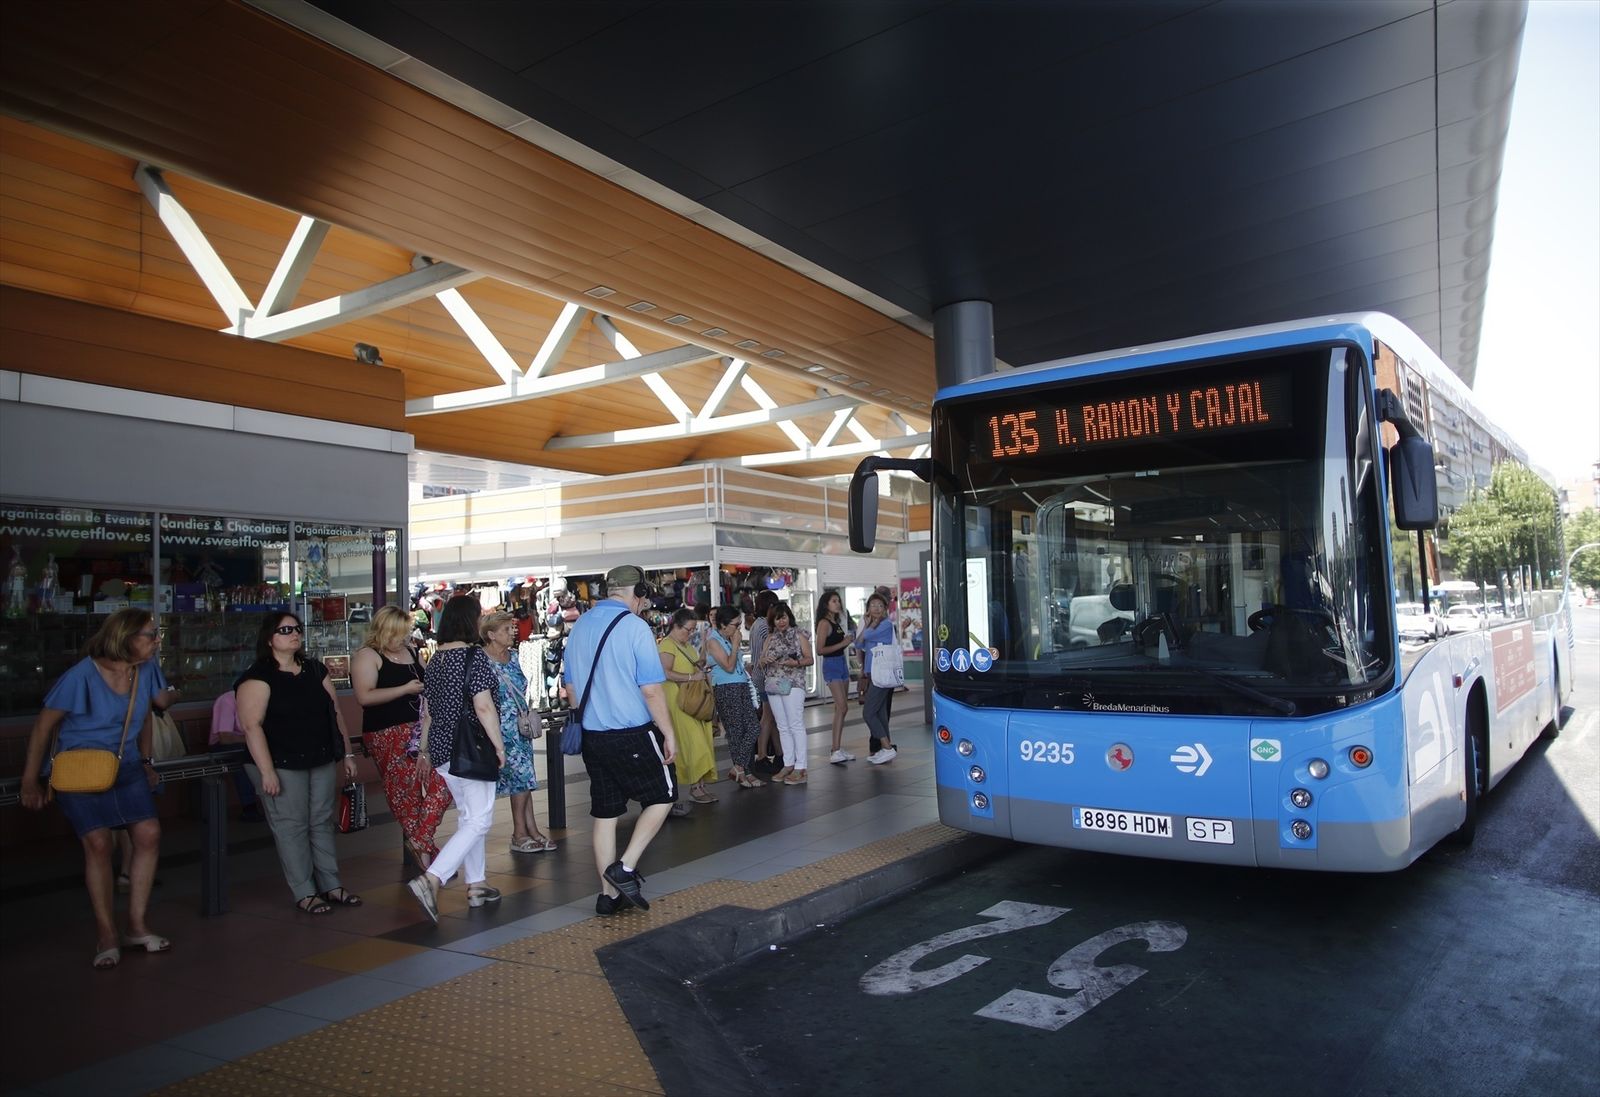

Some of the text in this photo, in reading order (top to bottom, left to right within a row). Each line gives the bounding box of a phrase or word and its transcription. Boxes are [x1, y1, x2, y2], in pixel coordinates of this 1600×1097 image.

[988, 381, 1270, 458] 135 H. RAMON Y CAJAL
[0, 508, 151, 527] rganización de Eventos
[160, 518, 288, 535] Candies & Chocolates
[160, 535, 288, 549] www.sweetflow.es
[1092, 702, 1170, 714] BredaMenarinibus
[1020, 740, 1075, 765] 9235
[1256, 746, 1275, 755] GNC
[1084, 811, 1168, 835] 8896 HDM
